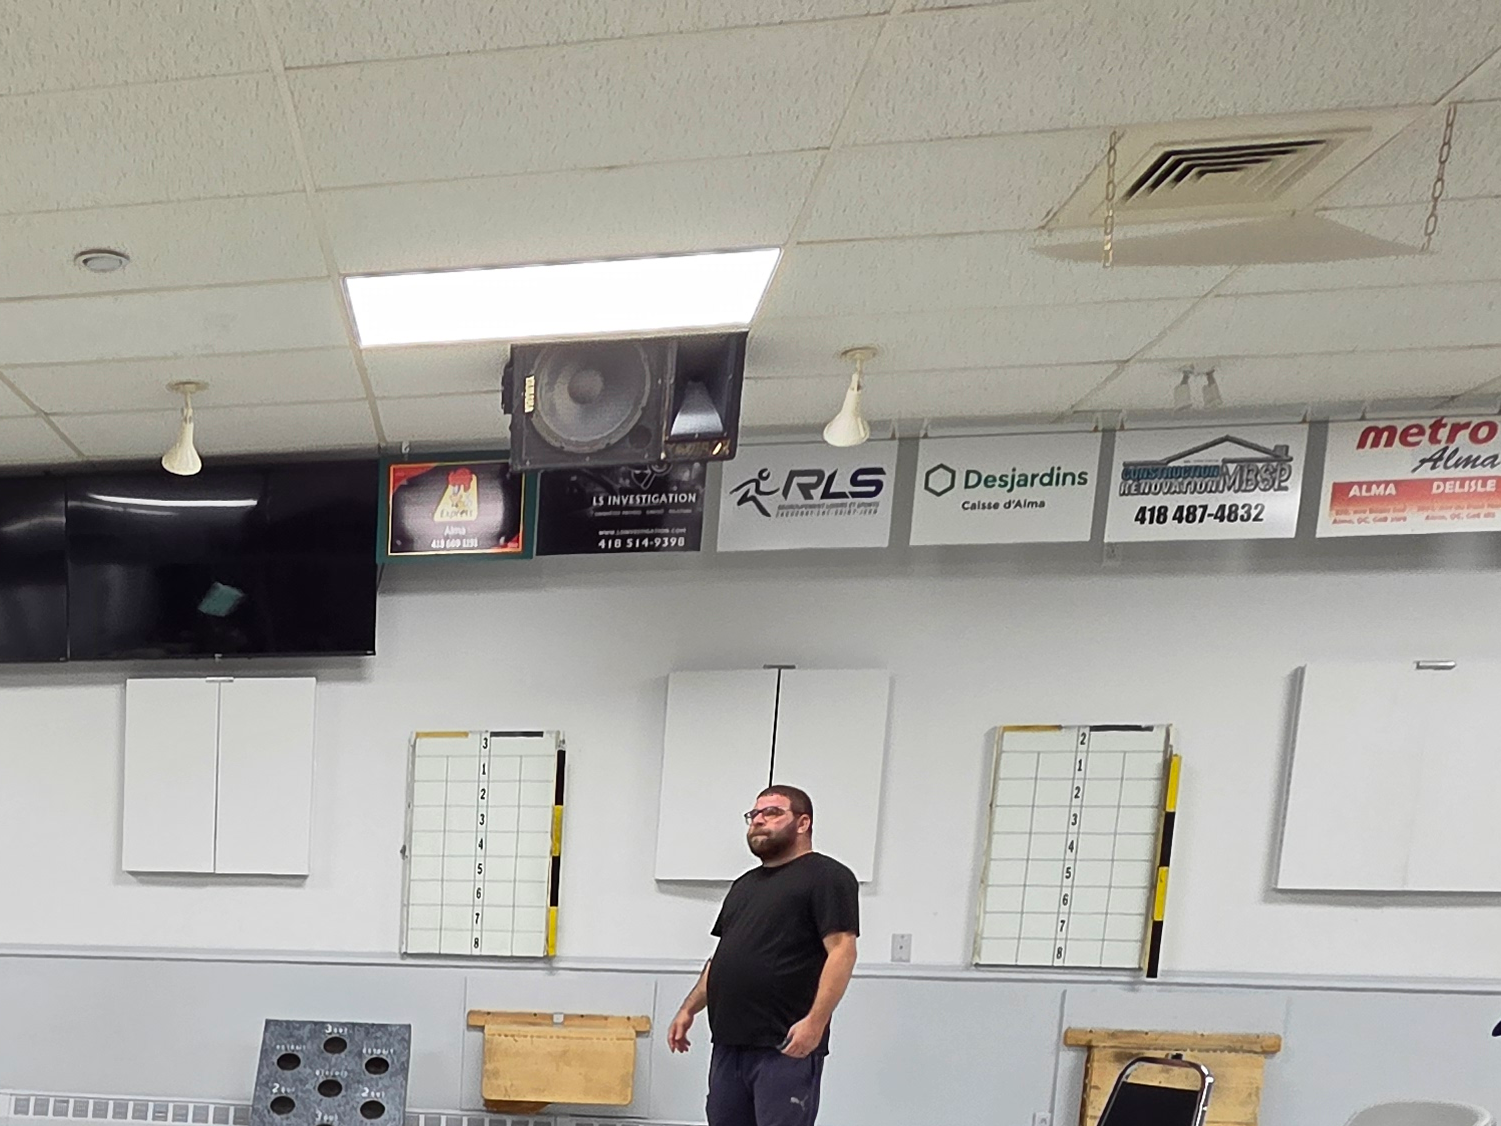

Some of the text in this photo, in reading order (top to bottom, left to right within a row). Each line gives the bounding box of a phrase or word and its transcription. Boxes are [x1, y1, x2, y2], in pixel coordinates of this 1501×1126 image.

[1356, 416, 1498, 450] metro
[1411, 446, 1501, 473] Alma
[1122, 465, 1220, 481] CONSTRUCTION
[782, 467, 886, 501] RLS
[964, 466, 1088, 493] Desjardins
[1349, 479, 1496, 498] ALMA DELISLE
[592, 492, 697, 506] LS INVESTIGATION
[961, 498, 1046, 511] Caisse d'Alma
[1134, 503, 1265, 525] 418 487-4832
[598, 536, 685, 549] 418 514-9398
[482, 737, 488, 749] 3
[1080, 733, 1086, 745] 2
[482, 764, 486, 775] 1
[1077, 759, 1082, 771] 1
[481, 789, 486, 800] 2
[1074, 786, 1081, 798] 2
[480, 814, 485, 825] 3
[1071, 814, 1078, 825] 3
[478, 839, 484, 850] 4
[1068, 840, 1074, 852] 4
[477, 863, 483, 875] 5
[1065, 867, 1072, 879] 5
[476, 888, 481, 899] 6
[1062, 894, 1068, 905] 6
[475, 913, 480, 924] 7
[1059, 920, 1065, 932] 7
